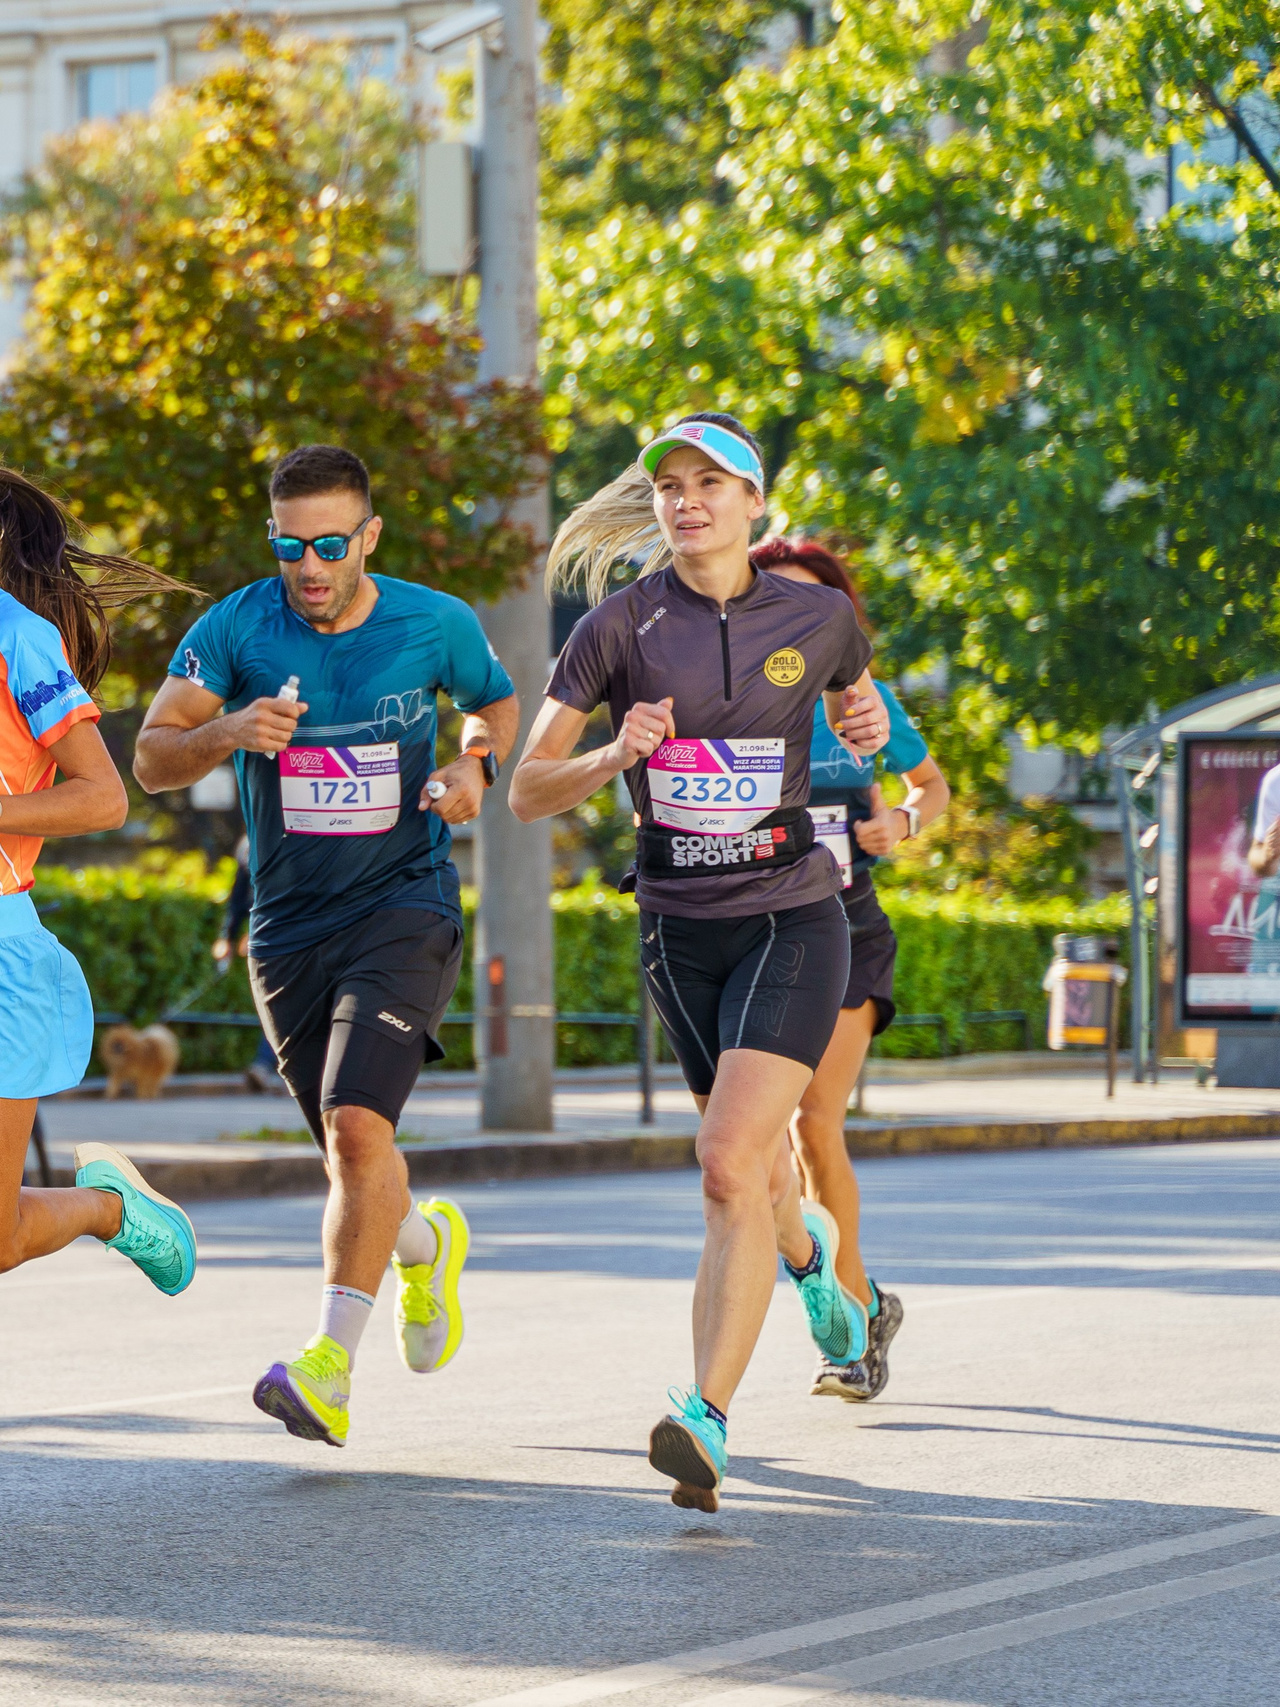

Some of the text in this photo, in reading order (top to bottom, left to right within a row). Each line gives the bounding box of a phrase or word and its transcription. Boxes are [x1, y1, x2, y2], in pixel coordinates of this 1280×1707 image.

[772, 656, 797, 665] GOLD
[361, 751, 383, 759] 21.098
[381, 761, 396, 769] SOFIA
[309, 781, 371, 804] 1721
[671, 776, 757, 802] 2320
[671, 826, 788, 852] COMPRES
[672, 846, 755, 867] SPORT
[377, 1011, 412, 1032] 2XU
